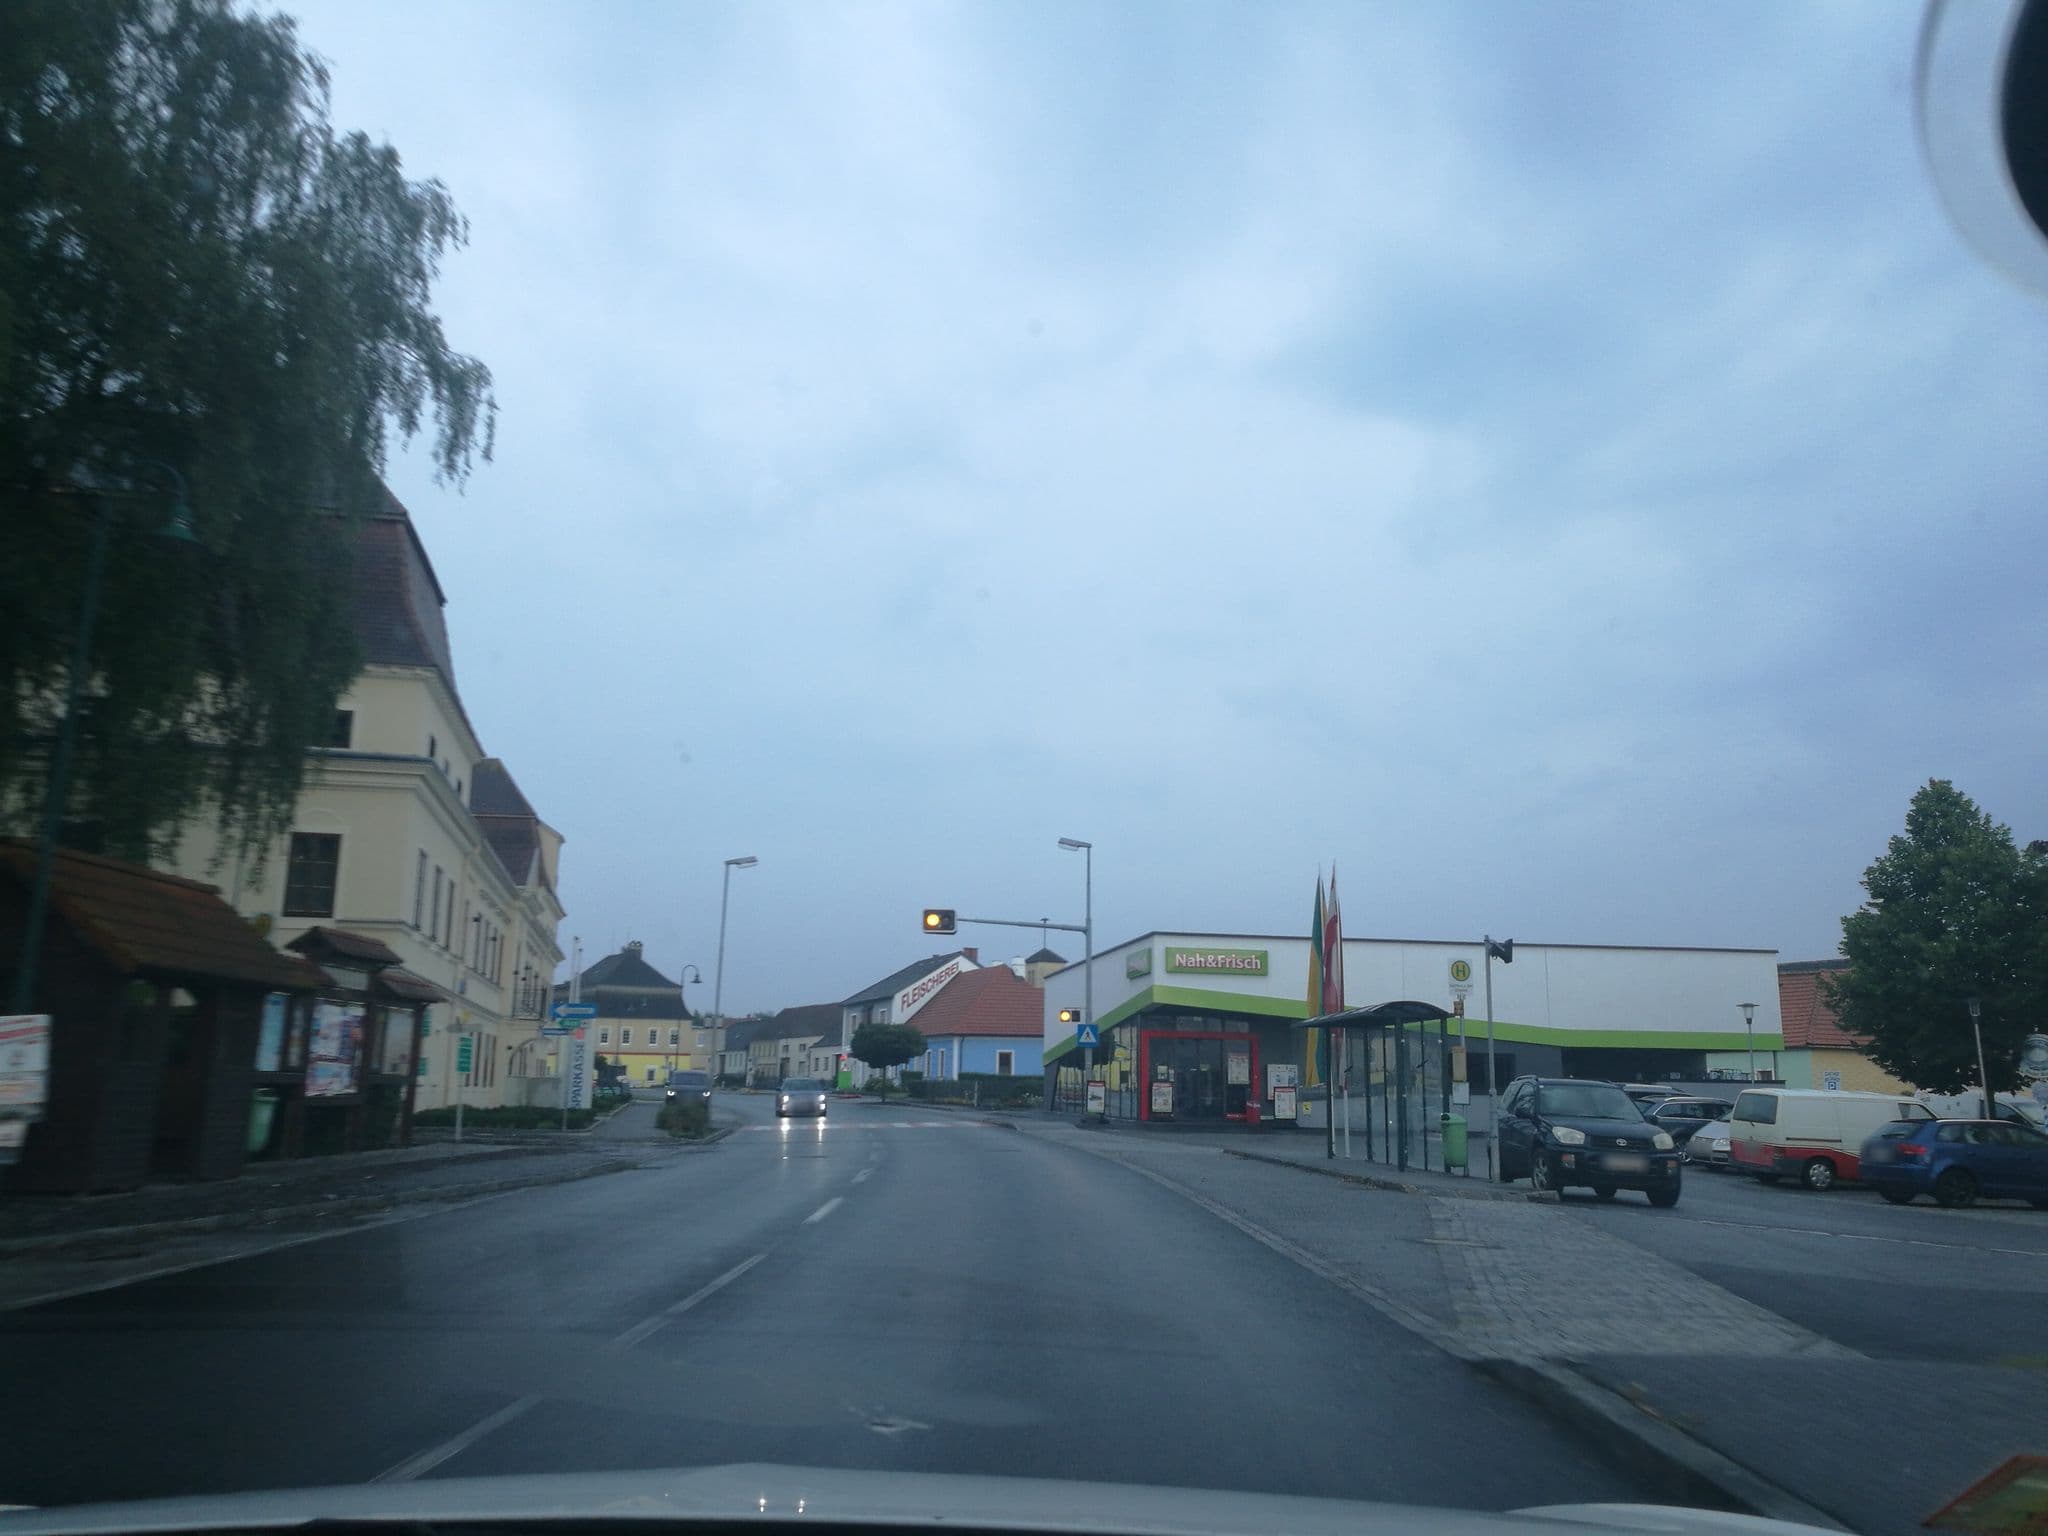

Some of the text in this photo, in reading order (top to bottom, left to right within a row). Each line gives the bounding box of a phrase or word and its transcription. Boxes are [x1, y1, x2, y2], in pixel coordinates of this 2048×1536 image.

[1175, 953, 1261, 969] Nah&Frisch
[1456, 964, 1466, 978] H
[901, 961, 960, 1013] FLEISCHEREI
[571, 1042, 585, 1107] SPARKASSE
